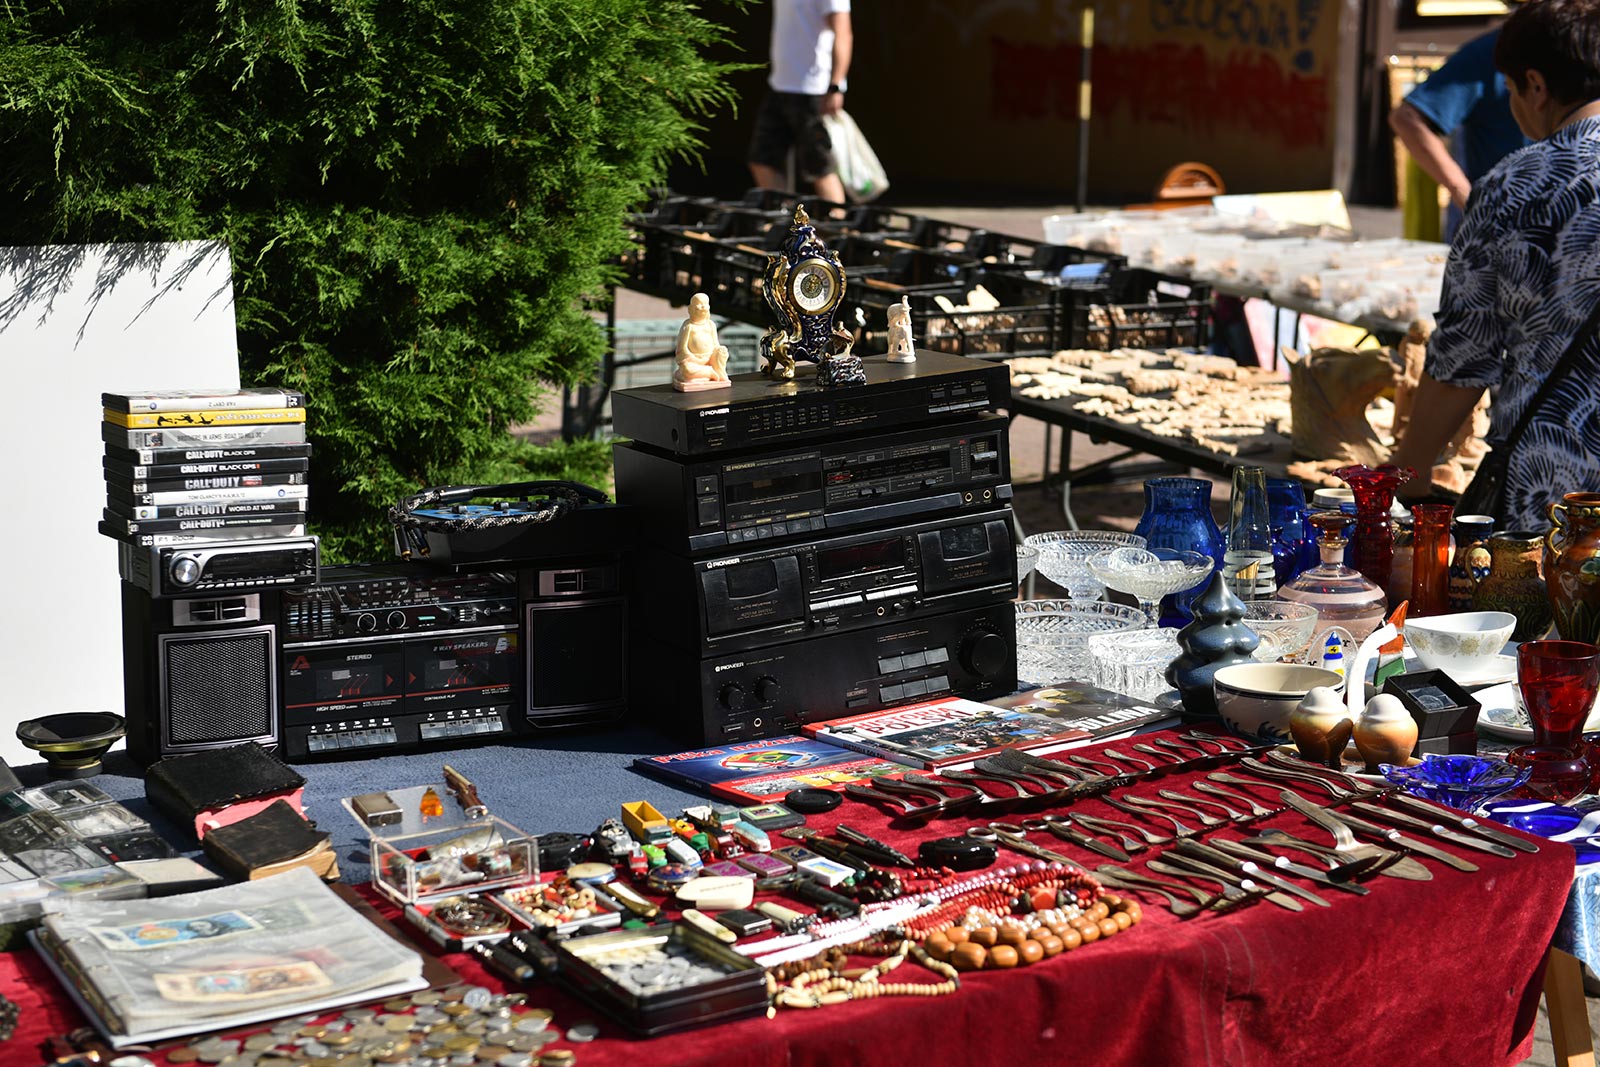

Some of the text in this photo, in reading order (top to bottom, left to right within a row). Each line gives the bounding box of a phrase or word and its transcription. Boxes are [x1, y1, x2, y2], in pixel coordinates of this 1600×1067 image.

[704, 408, 730, 417] PIONEER
[185, 450, 203, 460] CALL
[204, 449, 224, 459] DUTY
[180, 466, 197, 474] CALL
[198, 464, 217, 473] DUTY
[185, 478, 208, 490] CALL
[211, 476, 240, 488] DUTY
[176, 505, 200, 518] CALL
[201, 503, 228, 516] DUTY
[260, 503, 275, 511] WAR
[180, 520, 198, 530] CALL
[199, 519, 219, 529] DUTY
[713, 557, 741, 568] PIONEER
[453, 641, 489, 650] SPEAKERS
[346, 653, 373, 662] STEREO
[720, 661, 745, 671] PIONEER
[852, 706, 954, 731] HISTORIA
[864, 709, 975, 735] POLSKI
